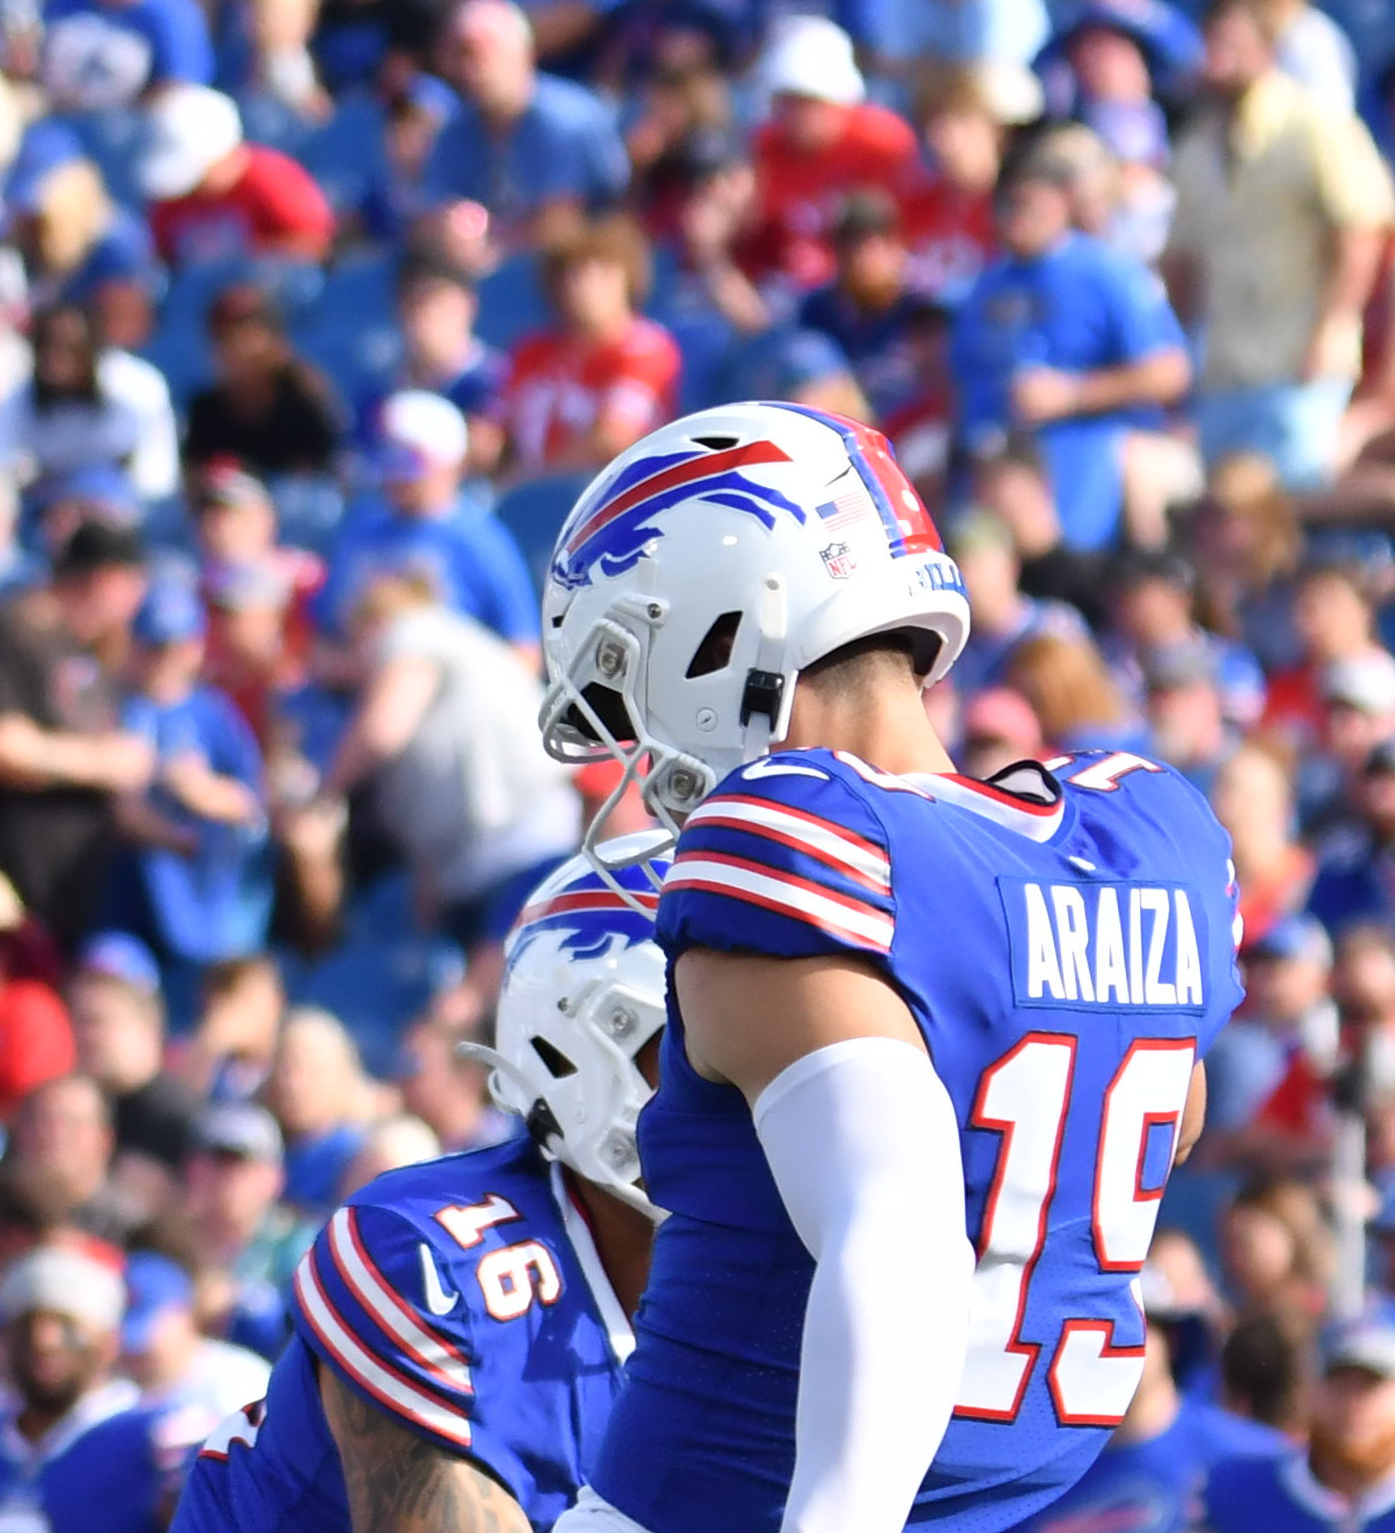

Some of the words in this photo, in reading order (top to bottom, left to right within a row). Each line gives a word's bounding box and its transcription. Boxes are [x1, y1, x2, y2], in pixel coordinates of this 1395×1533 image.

[1024, 882, 1202, 1006] ARAIZA
[430, 1191, 562, 1323] 16
[951, 1030, 1197, 1428] 19
